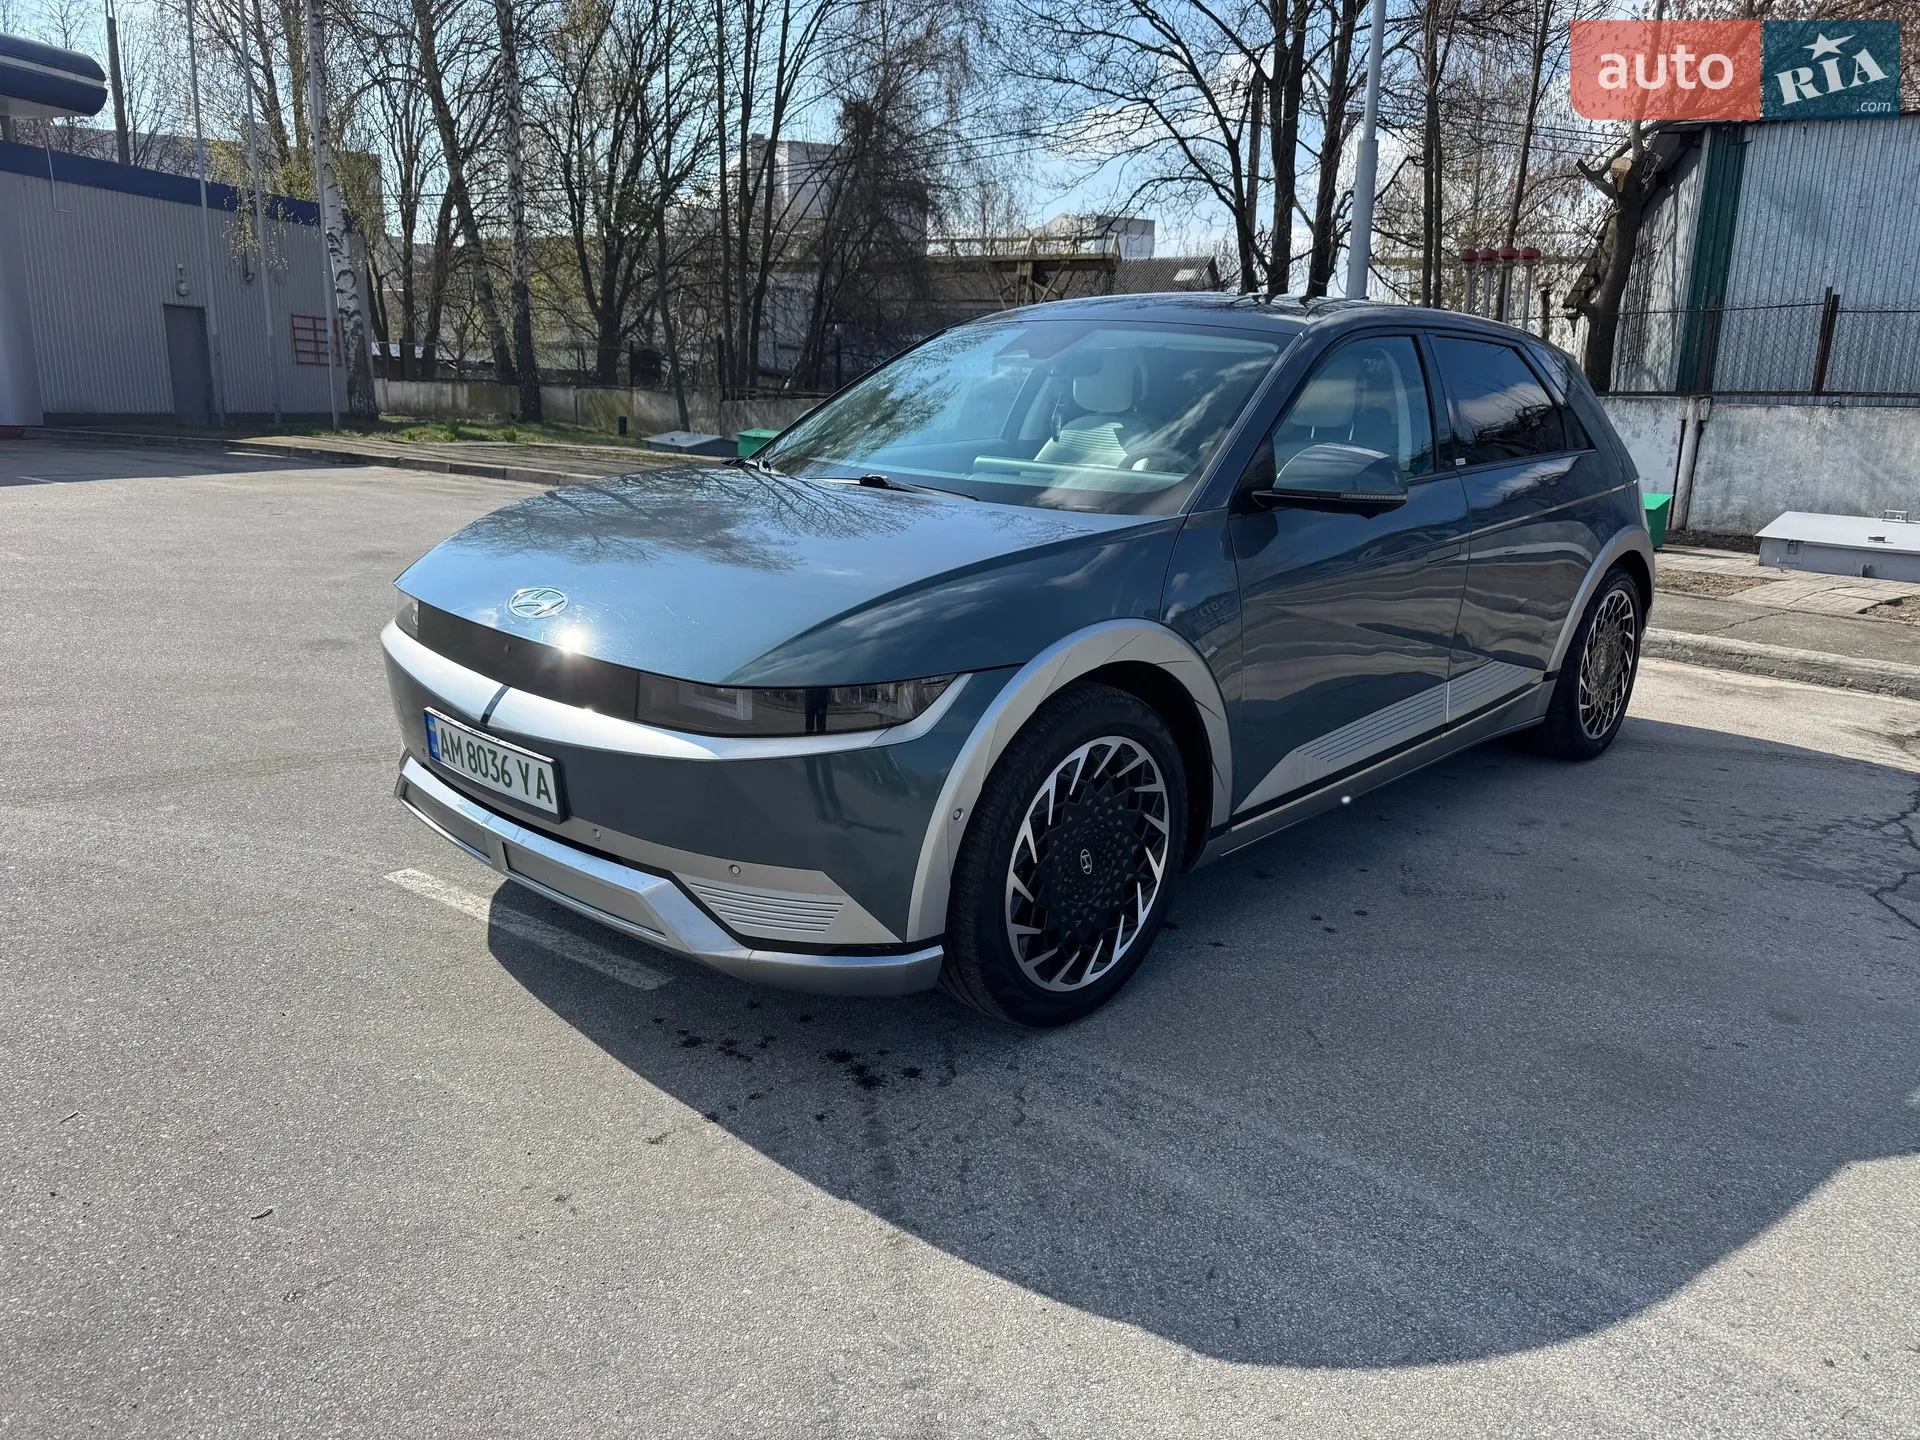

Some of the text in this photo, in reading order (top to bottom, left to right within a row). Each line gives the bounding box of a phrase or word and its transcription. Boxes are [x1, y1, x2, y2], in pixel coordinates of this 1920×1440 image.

[440, 727, 553, 804] AM 8036 YA
